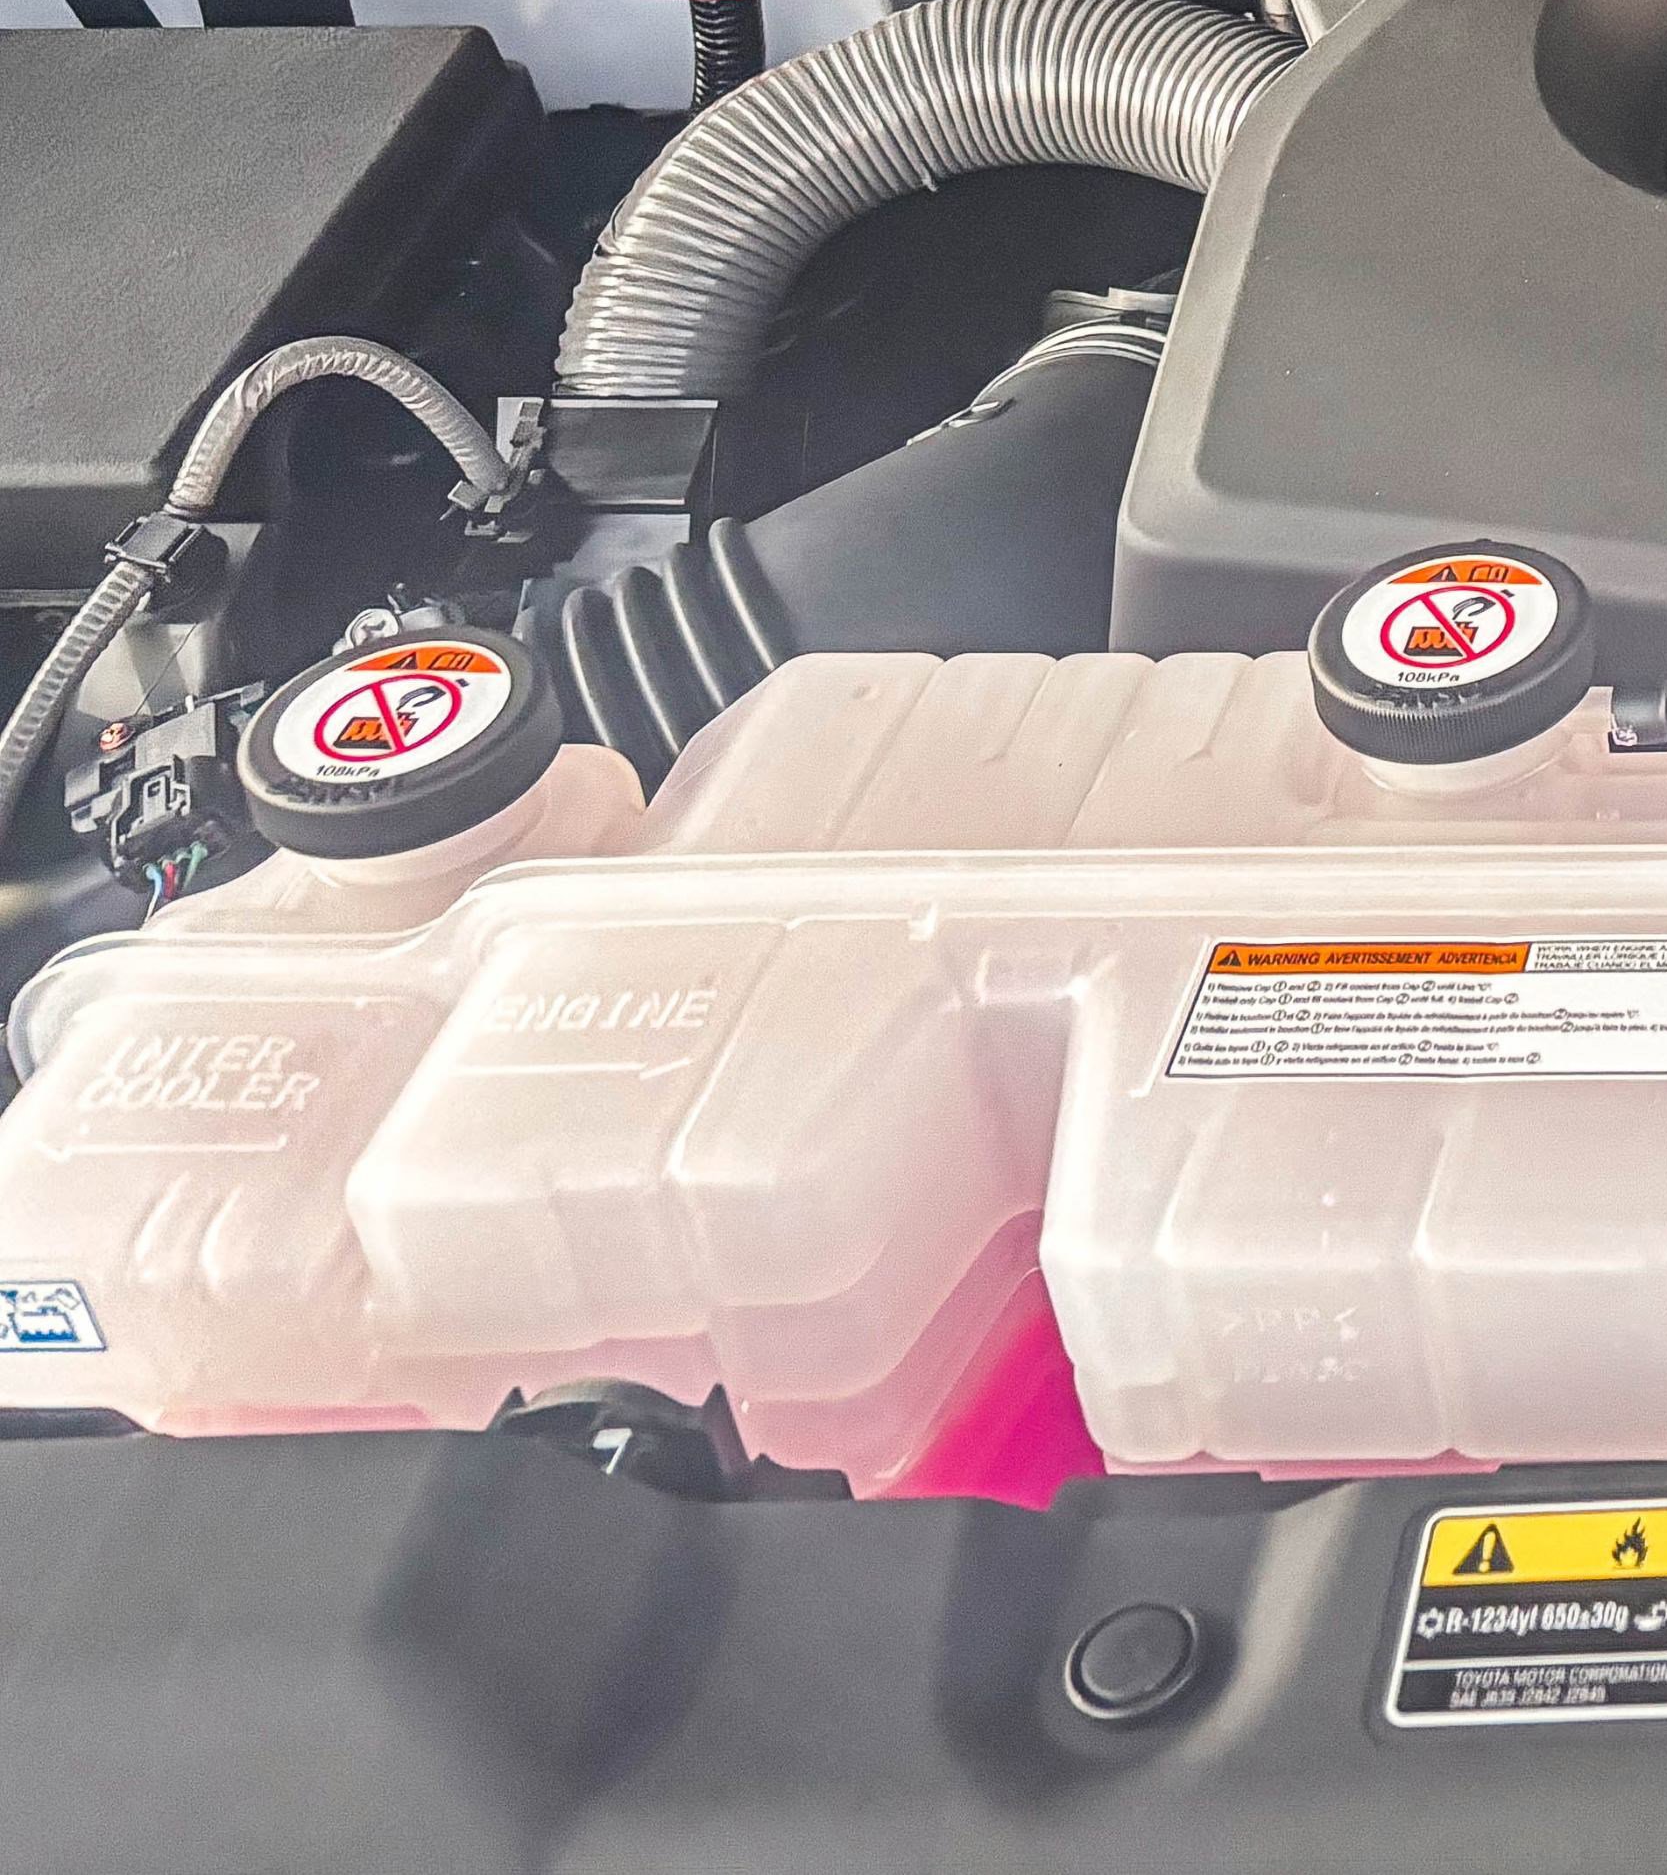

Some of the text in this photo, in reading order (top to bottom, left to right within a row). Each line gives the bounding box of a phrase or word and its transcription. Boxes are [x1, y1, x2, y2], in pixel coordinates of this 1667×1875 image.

[1398, 672, 1461, 683] 108kPa
[316, 765, 380, 777] 108kPa
[1248, 952, 1517, 966] WARNING AVERTISSEMENT ADVERTENCIA
[482, 989, 718, 1033] ENGINE
[101, 1035, 296, 1077] INTER
[79, 1073, 319, 1112] COOLER
[1455, 1669, 1510, 1687] TOYOTA
[1514, 1666, 1565, 1685] MOTOR
[1450, 1690, 1478, 1708] SAE
